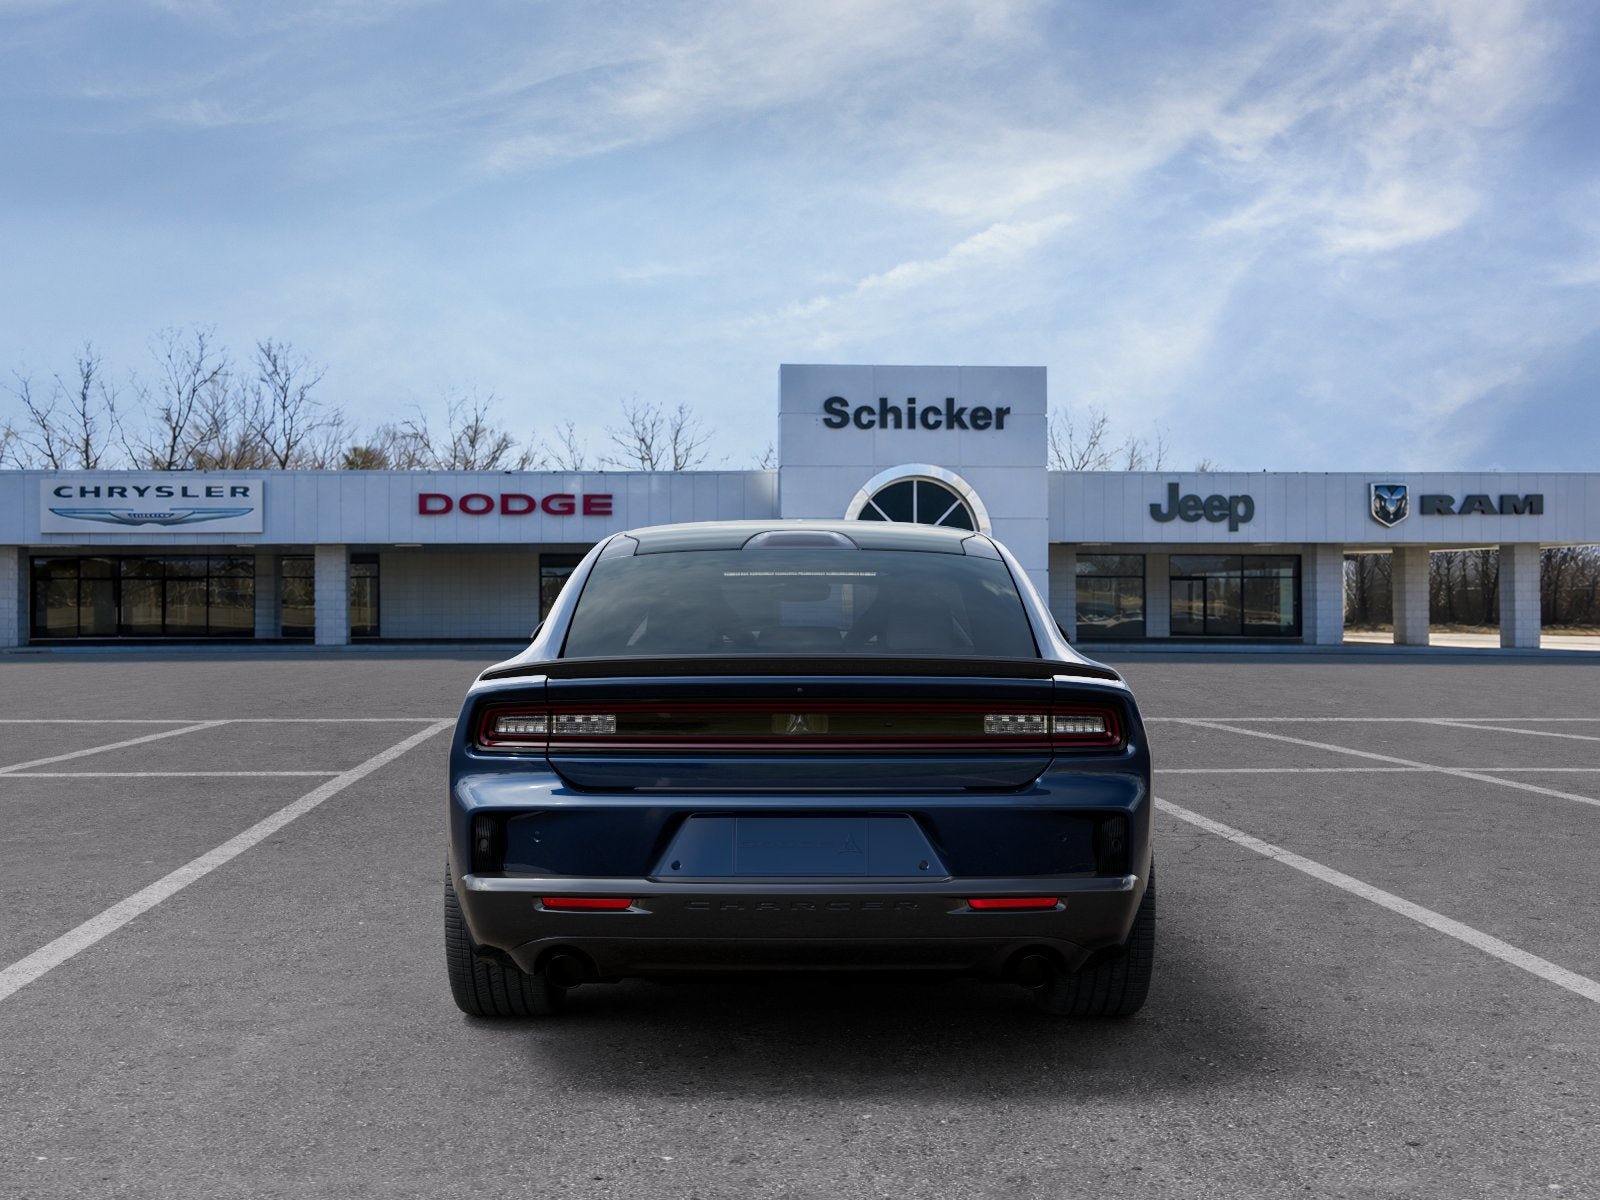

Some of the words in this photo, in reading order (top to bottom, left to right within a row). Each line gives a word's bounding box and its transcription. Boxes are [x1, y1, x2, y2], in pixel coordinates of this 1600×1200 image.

[822, 396, 1011, 431] Schicker
[53, 485, 251, 498] CHRYSLER
[418, 493, 613, 516] DODGE
[1149, 482, 1255, 532] Jeep
[1419, 494, 1544, 516] RAM
[683, 901, 921, 911] CHARGER
